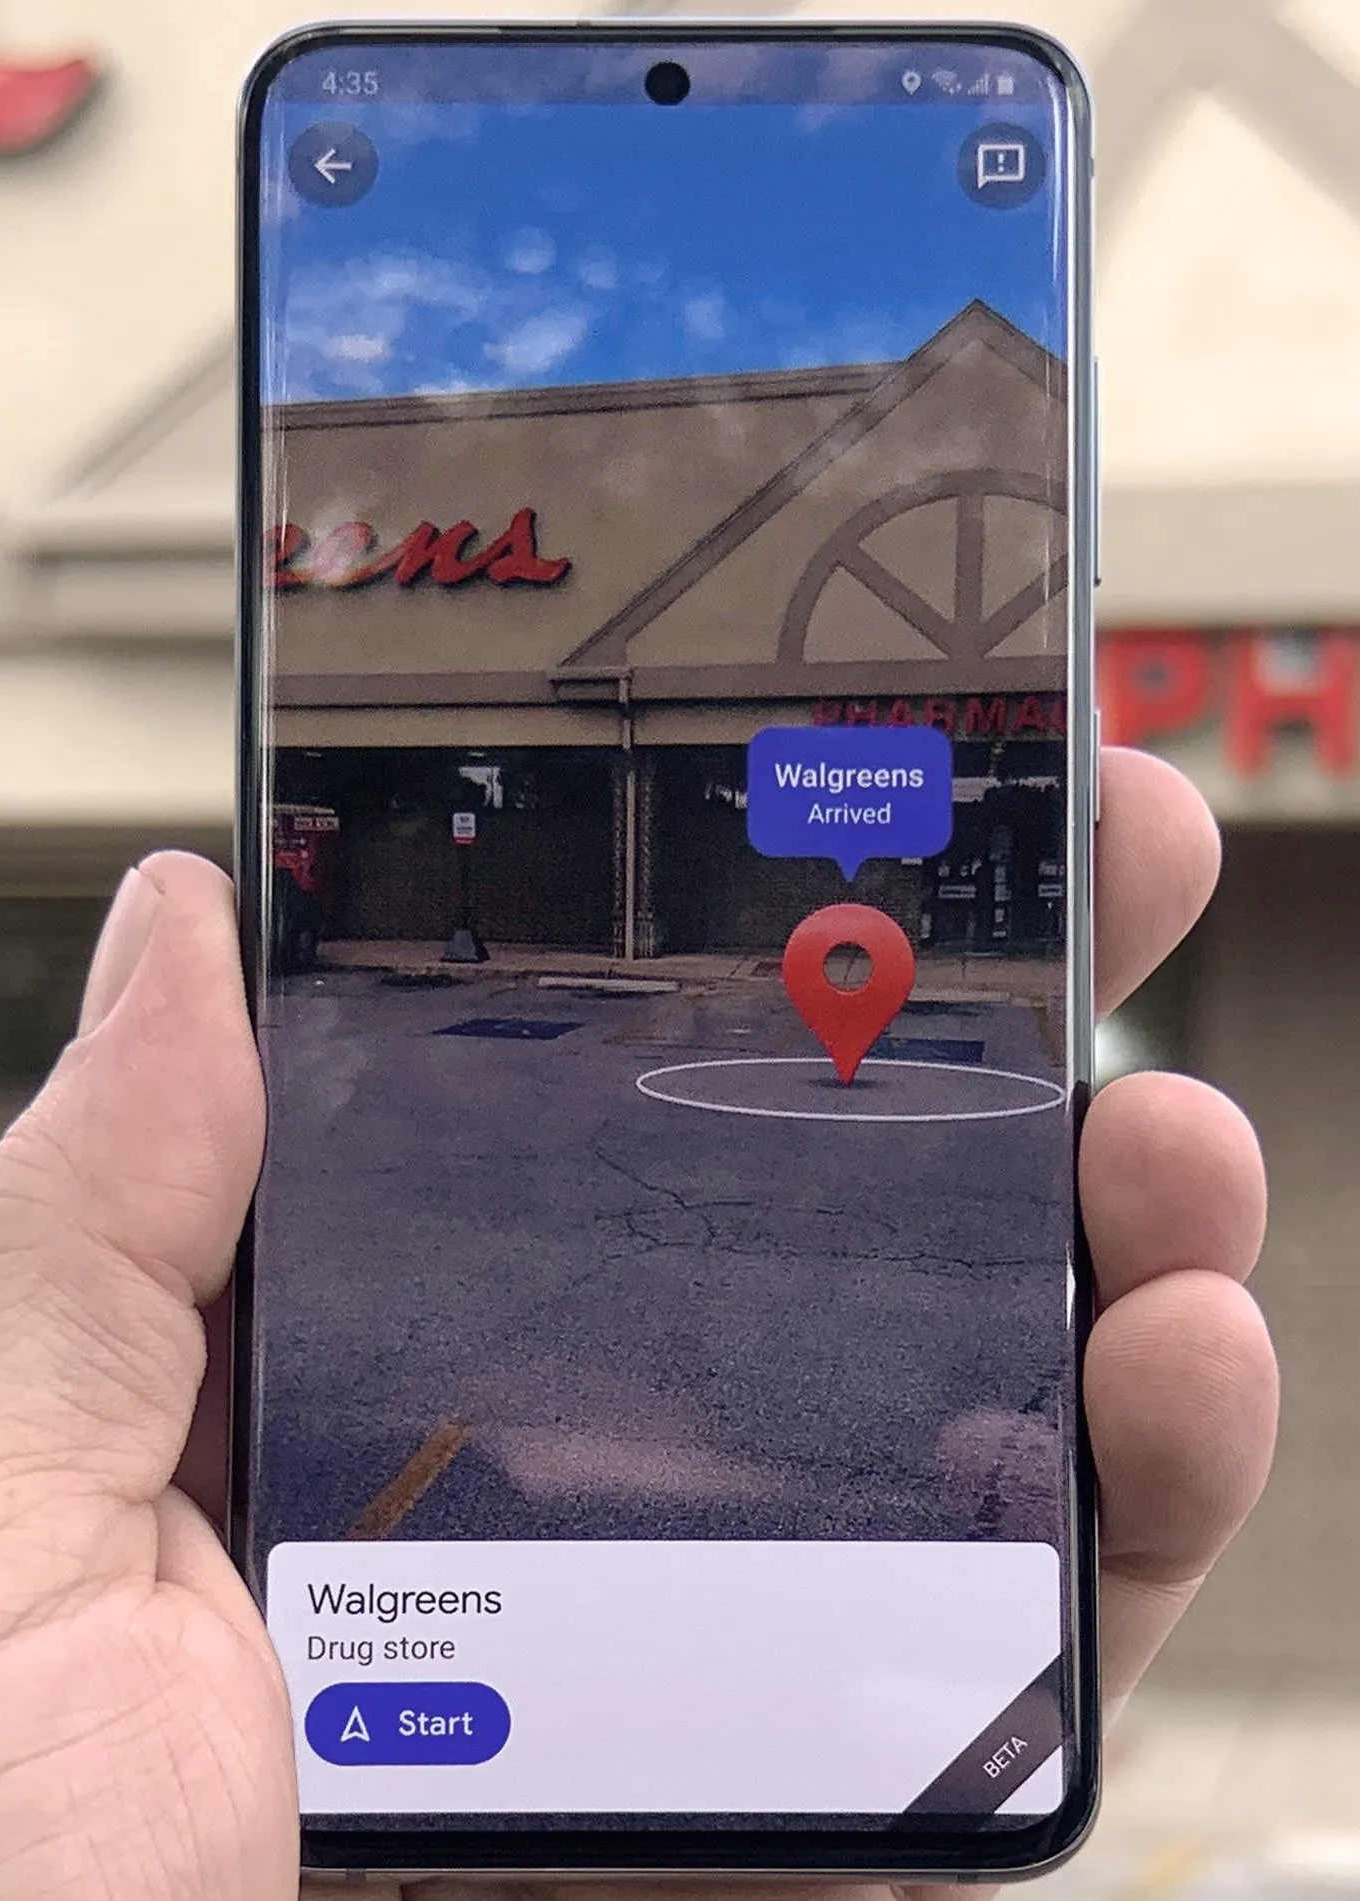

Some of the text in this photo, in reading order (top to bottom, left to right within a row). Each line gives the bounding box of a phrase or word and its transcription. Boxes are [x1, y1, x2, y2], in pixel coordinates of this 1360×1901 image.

[323, 71, 379, 95] 4:35
[775, 763, 925, 794] Walgreens
[807, 802, 892, 825] Arrived
[307, 1583, 502, 1624] Walgreens
[307, 1635, 456, 1666] Drug store
[398, 1709, 473, 1736] Start
[982, 1736, 1028, 1778] BETA
